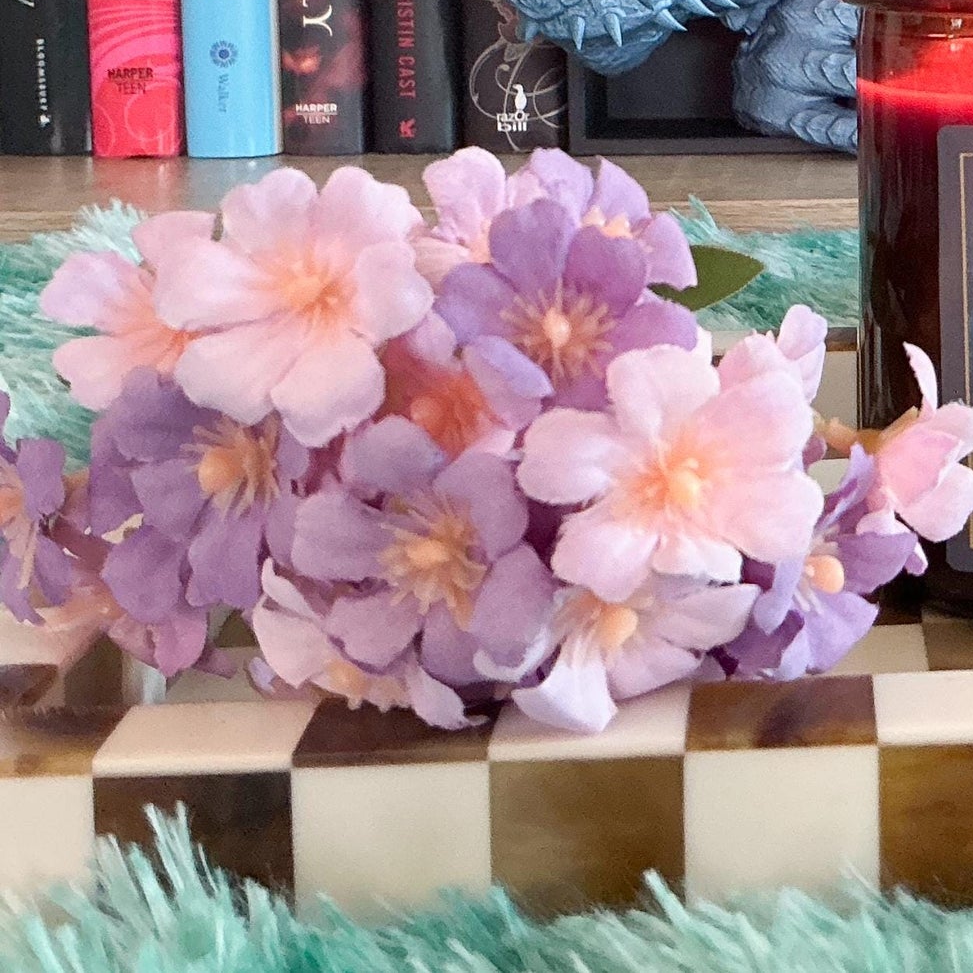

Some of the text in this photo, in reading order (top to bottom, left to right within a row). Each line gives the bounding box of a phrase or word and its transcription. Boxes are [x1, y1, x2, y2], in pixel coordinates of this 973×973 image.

[107, 68, 153, 80] HARPER
[398, 57, 416, 98] CAST
[116, 82, 146, 95] TEEN
[296, 103, 338, 113] HARPER
[303, 115, 330, 124] TEEN
